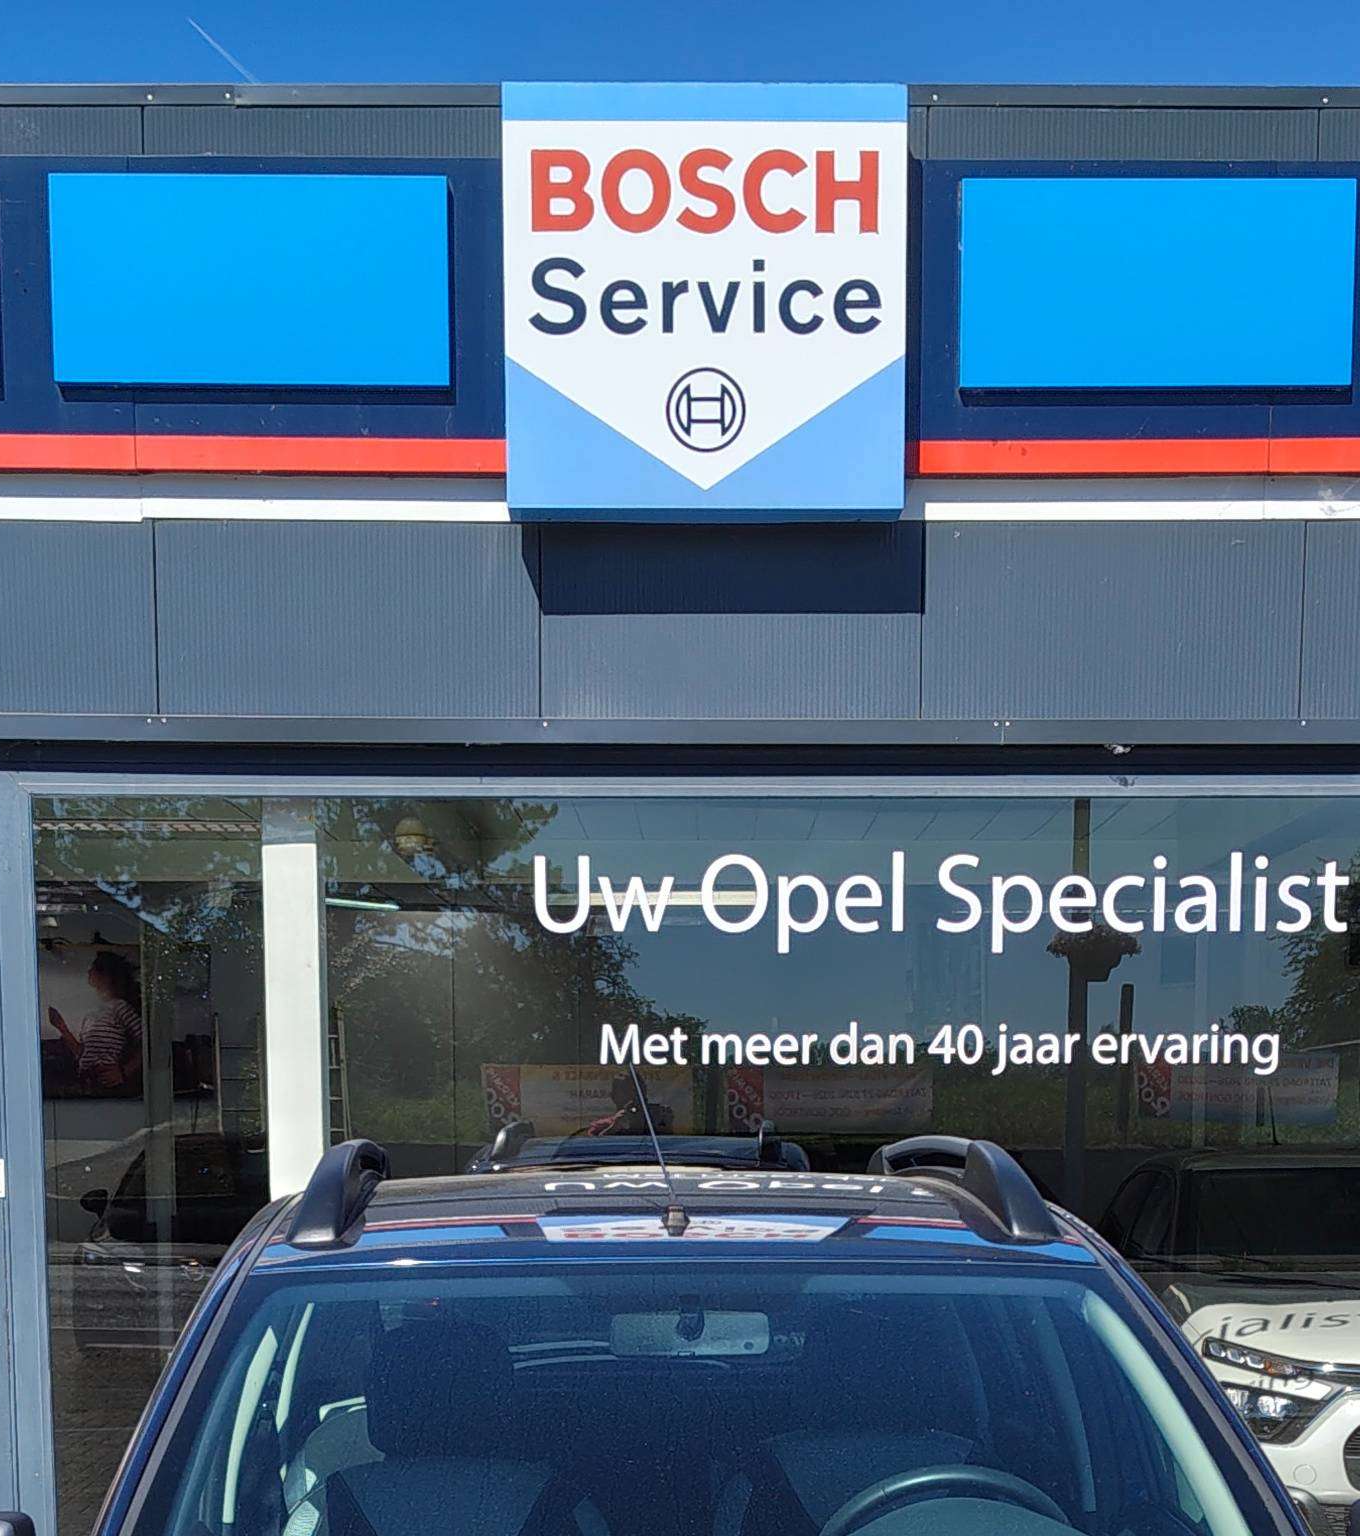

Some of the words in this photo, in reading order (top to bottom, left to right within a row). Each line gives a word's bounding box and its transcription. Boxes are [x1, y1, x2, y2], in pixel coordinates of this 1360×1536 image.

[530, 148, 879, 234] BOSCH
[528, 256, 882, 336] Service
[533, 855, 676, 934] Uw
[698, 850, 905, 954] Opel
[936, 851, 1350, 954] Specialist
[599, 1023, 689, 1066] Met
[701, 1033, 819, 1066] meer
[828, 1021, 915, 1066] dan
[926, 1024, 983, 1066] 40
[990, 1023, 1081, 1076] jaar
[1091, 1022, 1280, 1076] ervaring
